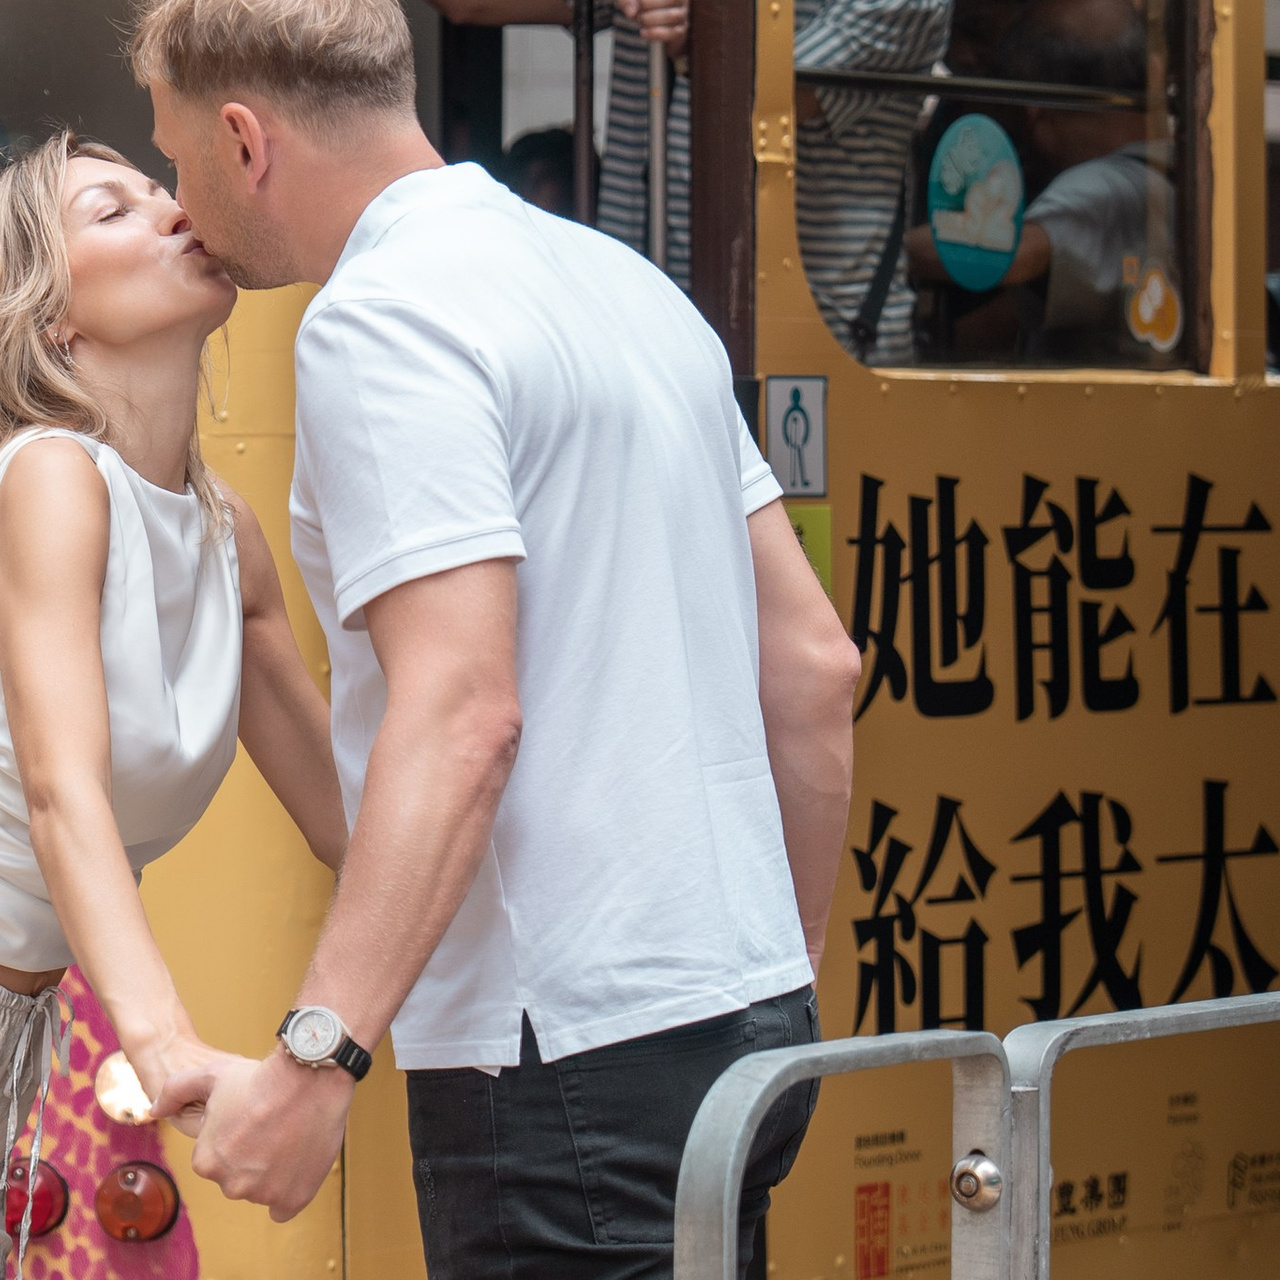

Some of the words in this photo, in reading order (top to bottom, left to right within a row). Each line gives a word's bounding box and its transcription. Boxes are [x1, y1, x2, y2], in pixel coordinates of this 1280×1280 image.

[847, 472, 1279, 726] 她能在
[850, 780, 1280, 1035] 給我太
